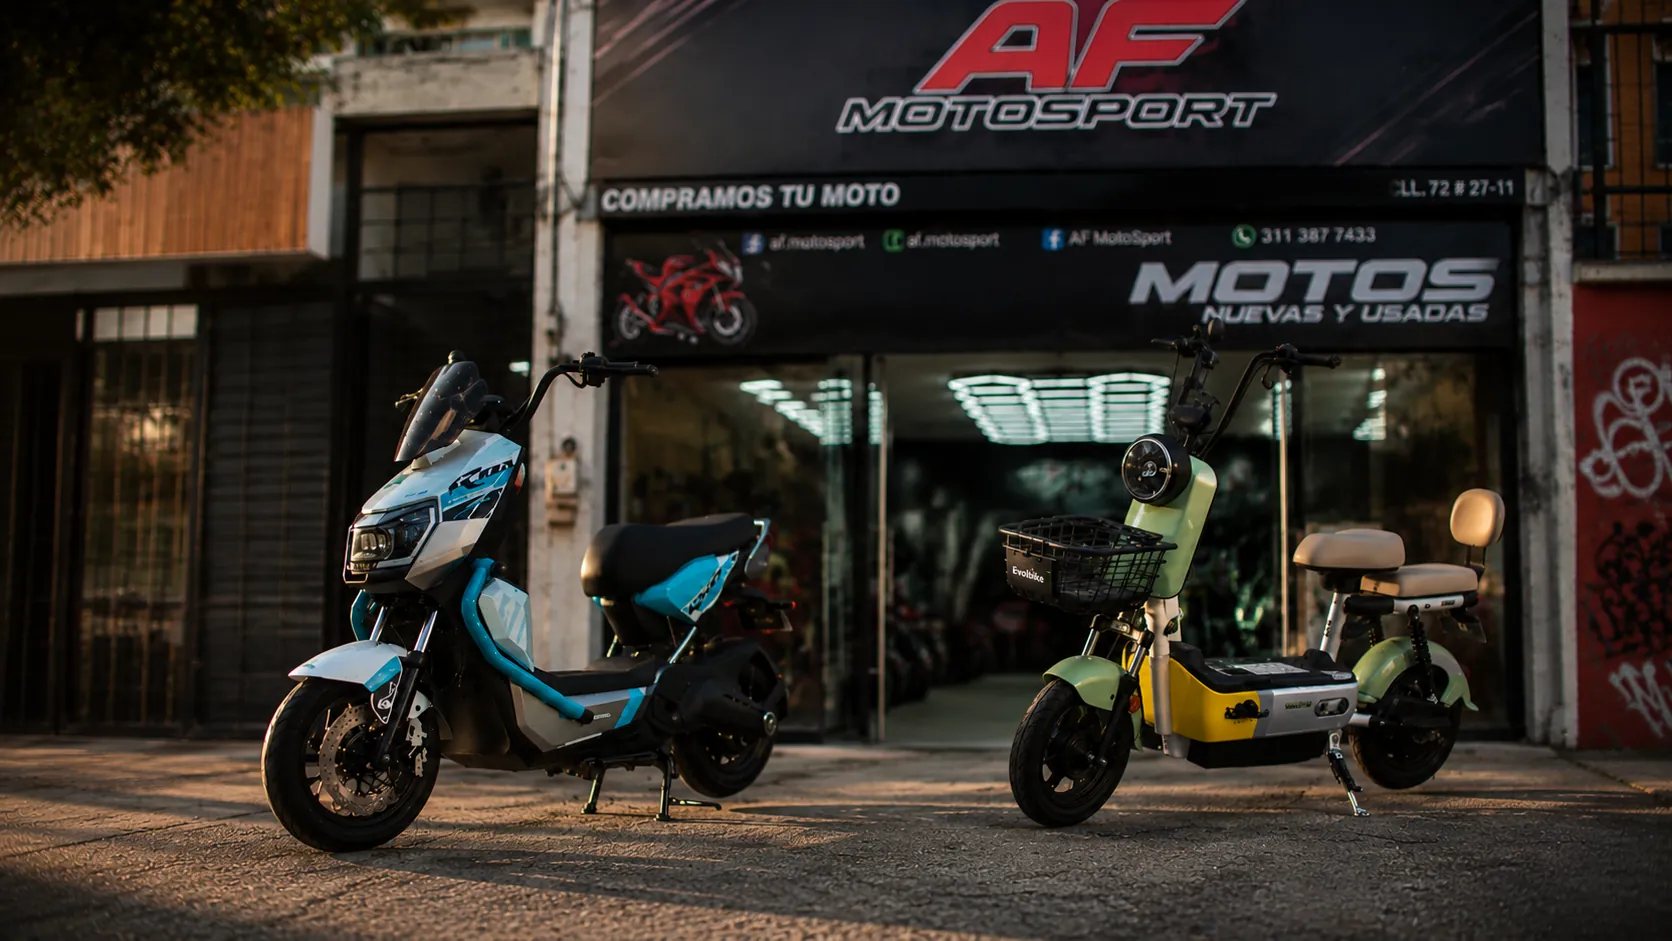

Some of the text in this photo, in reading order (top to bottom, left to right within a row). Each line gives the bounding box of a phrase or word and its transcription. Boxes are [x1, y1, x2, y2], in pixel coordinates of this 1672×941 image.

[914, 0, 1246, 94] AF
[836, 92, 1277, 133] MOTOSPORT
[602, 182, 900, 212] COMPRAMOS TU MOTO
[1428, 179, 1450, 197] 72
[1454, 180, 1465, 196] #
[1469, 179, 1513, 197] 27-11
[1068, 229, 1172, 248] AF MotoSport
[1260, 226, 1376, 244] 311 387 7433
[1129, 257, 1499, 304] MOTOS
[1201, 303, 1490, 323] NUEVAS Y USADAS
